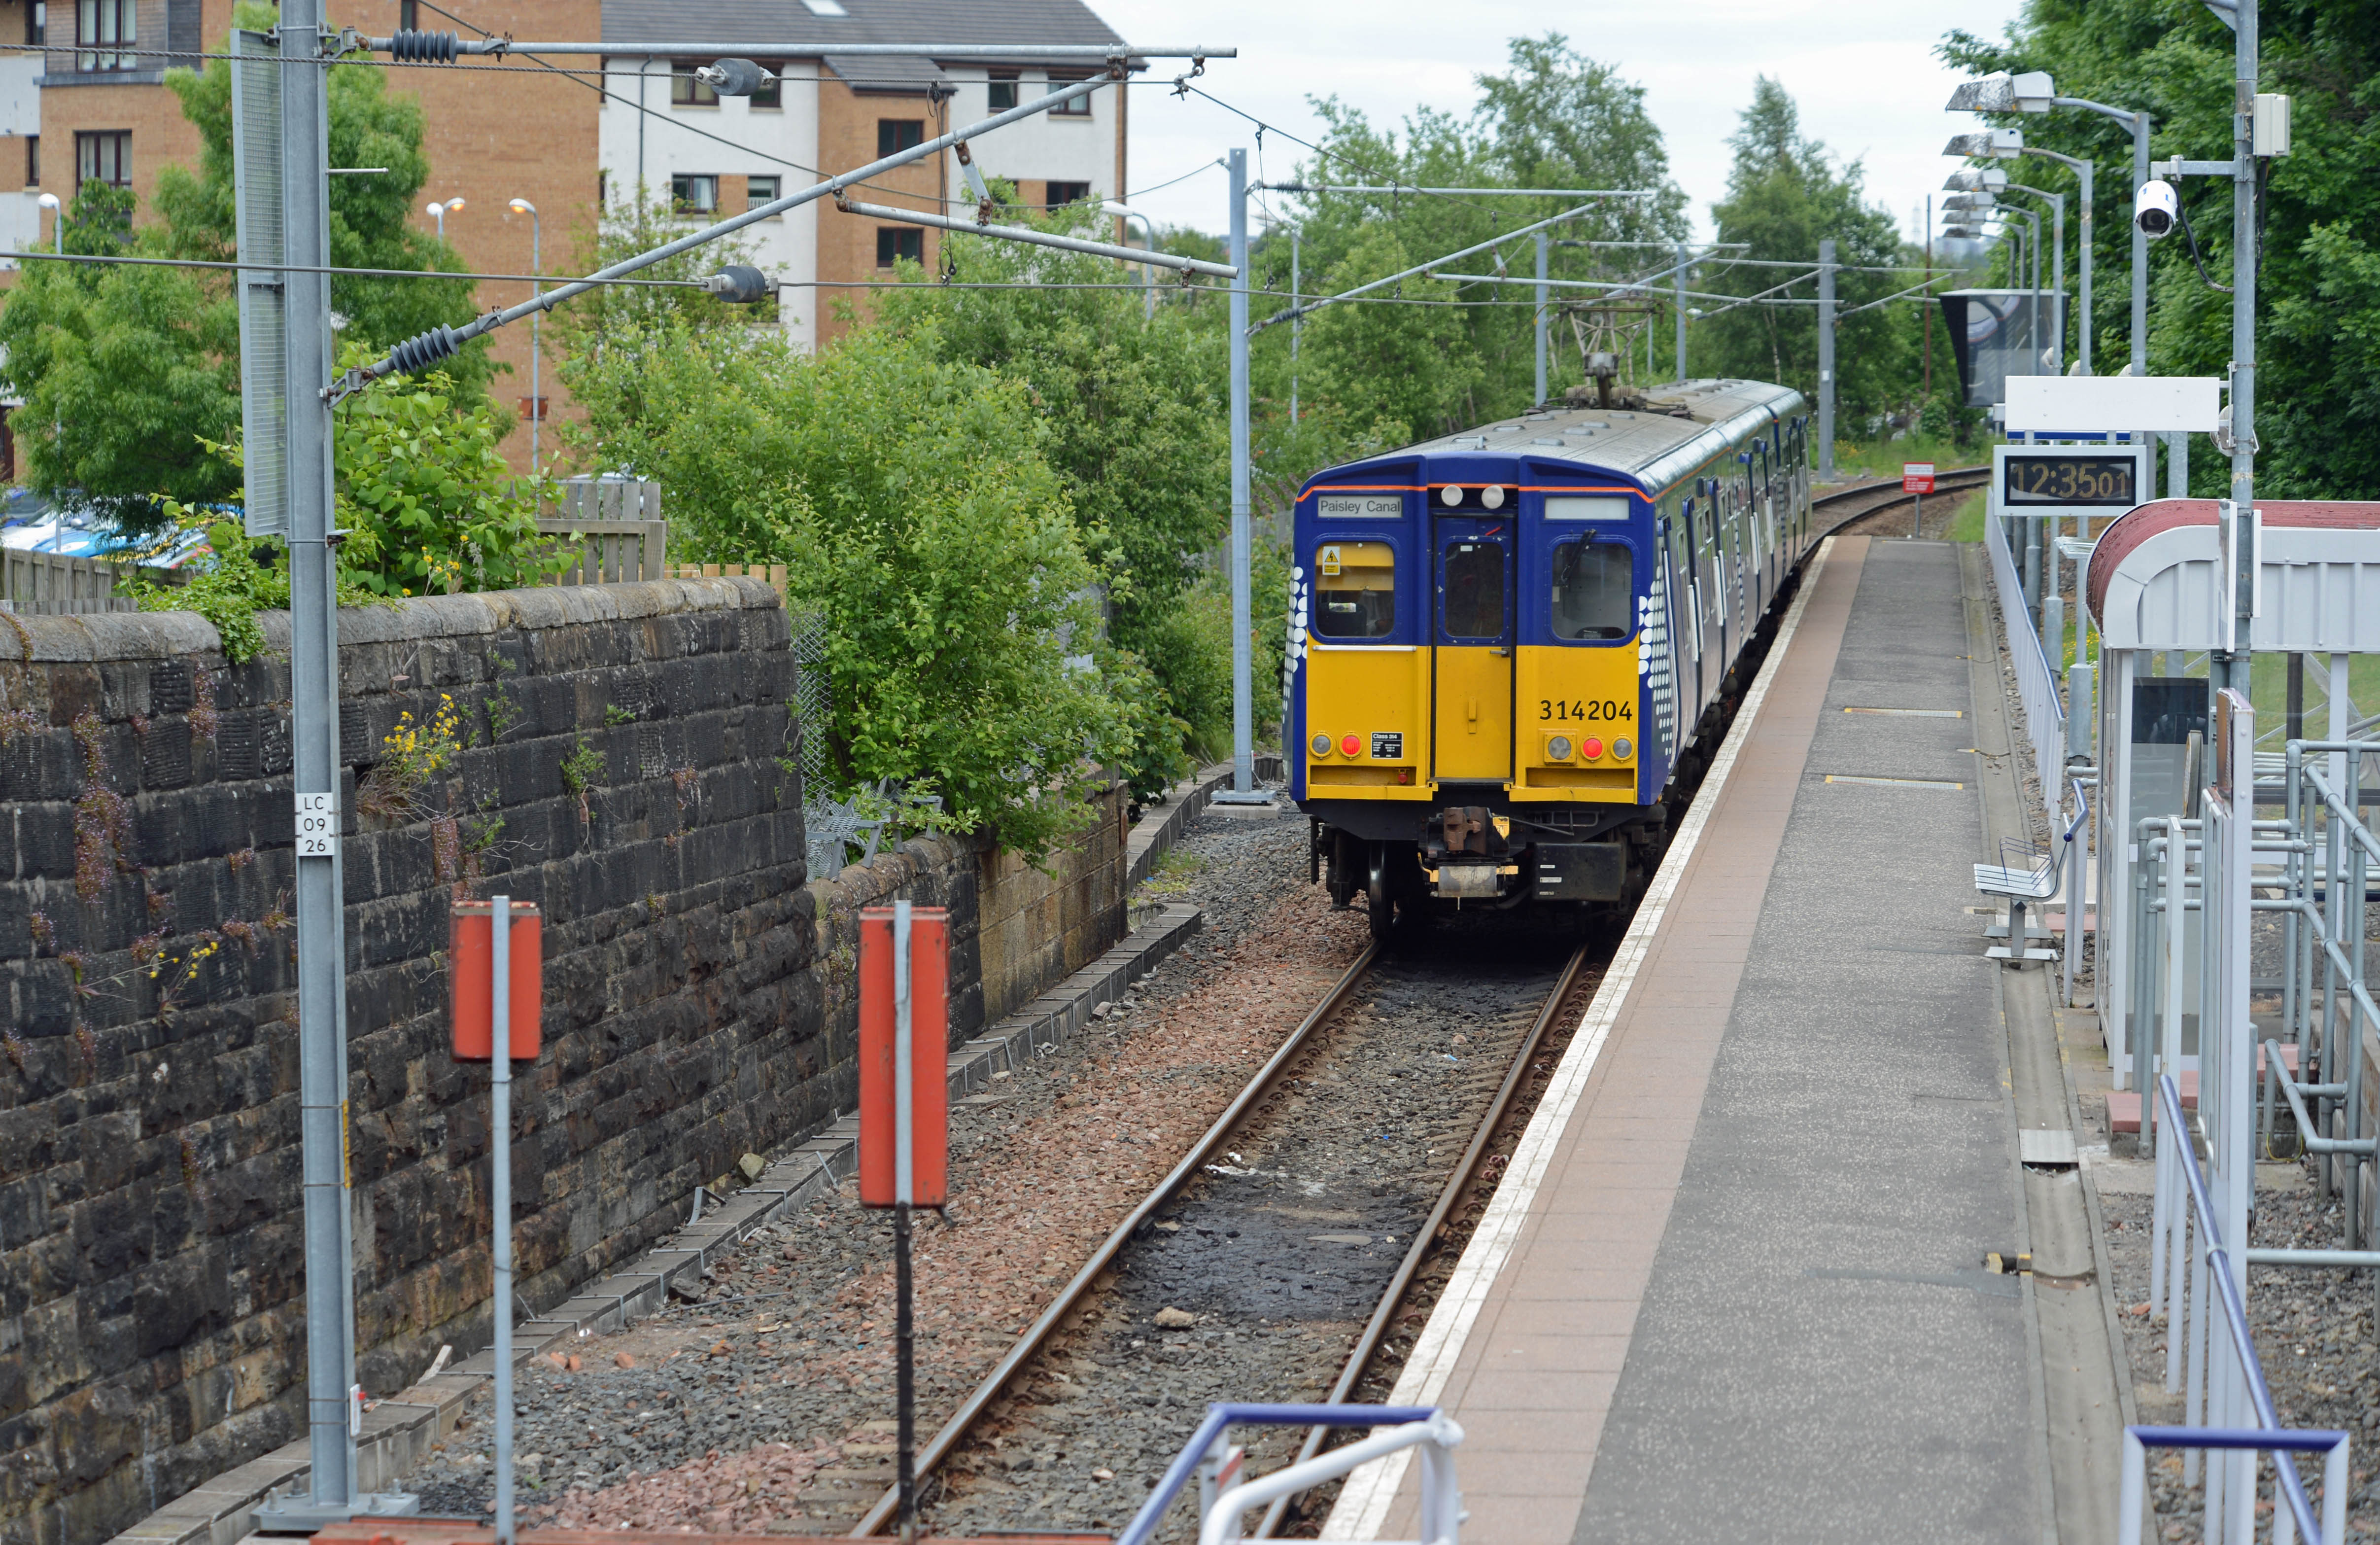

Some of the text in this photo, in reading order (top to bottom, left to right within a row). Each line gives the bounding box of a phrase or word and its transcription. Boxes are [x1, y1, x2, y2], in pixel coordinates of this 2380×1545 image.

[1321, 500, 1400, 514] Paisley Canal
[1540, 700, 1632, 721] 314204
[305, 796, 324, 809] LC
[304, 818, 325, 831] 09
[306, 839, 326, 852] 26
